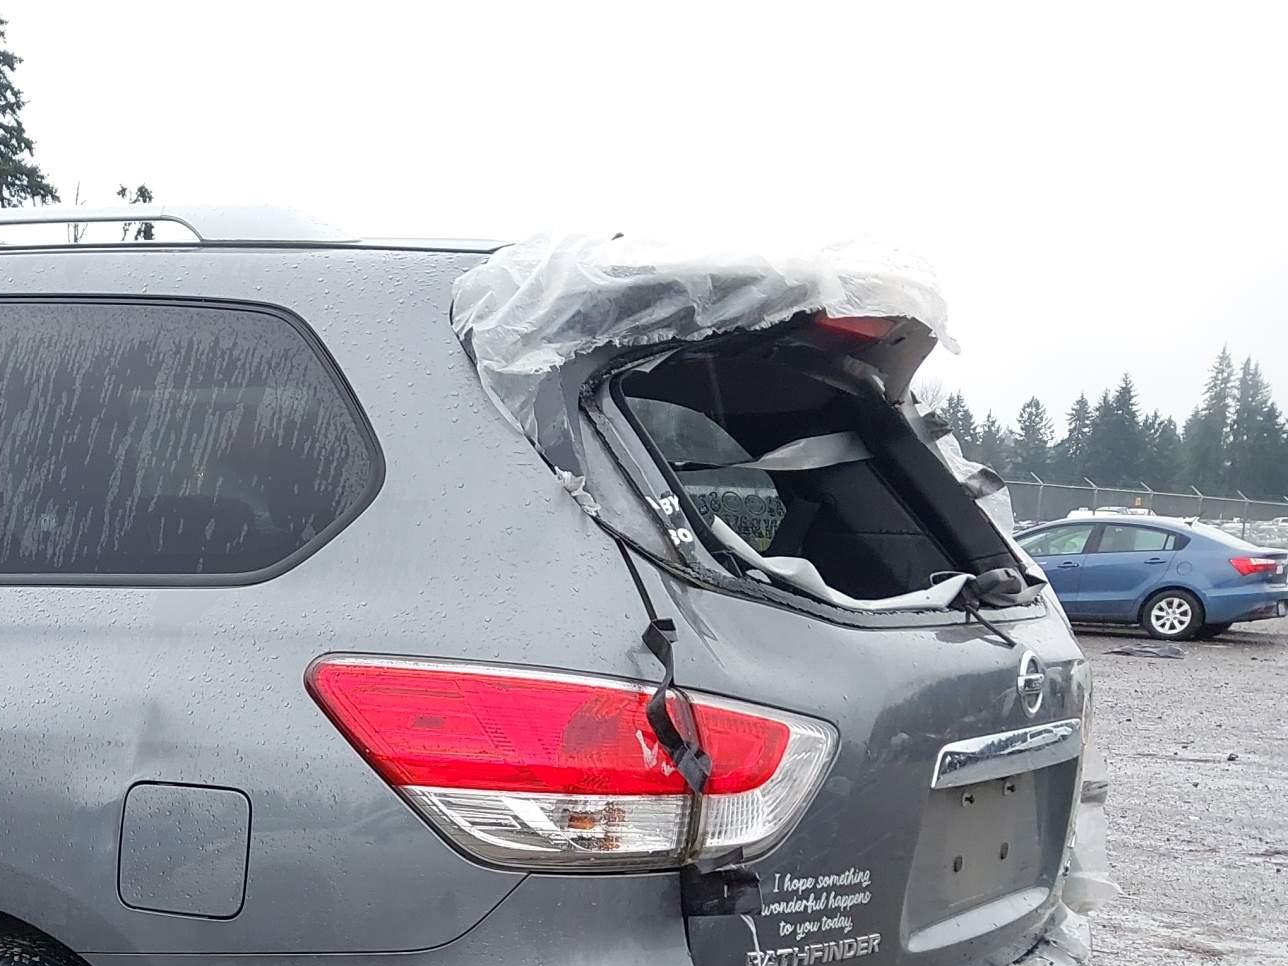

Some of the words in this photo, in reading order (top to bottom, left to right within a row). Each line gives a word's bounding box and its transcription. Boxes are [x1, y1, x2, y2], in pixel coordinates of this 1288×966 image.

[773, 873, 781, 893] I
[784, 873, 815, 894] hope
[816, 867, 872, 888] something
[762, 892, 826, 916] wonderful
[828, 891, 872, 911] happens
[779, 920, 794, 936] to
[796, 921, 820, 940] you
